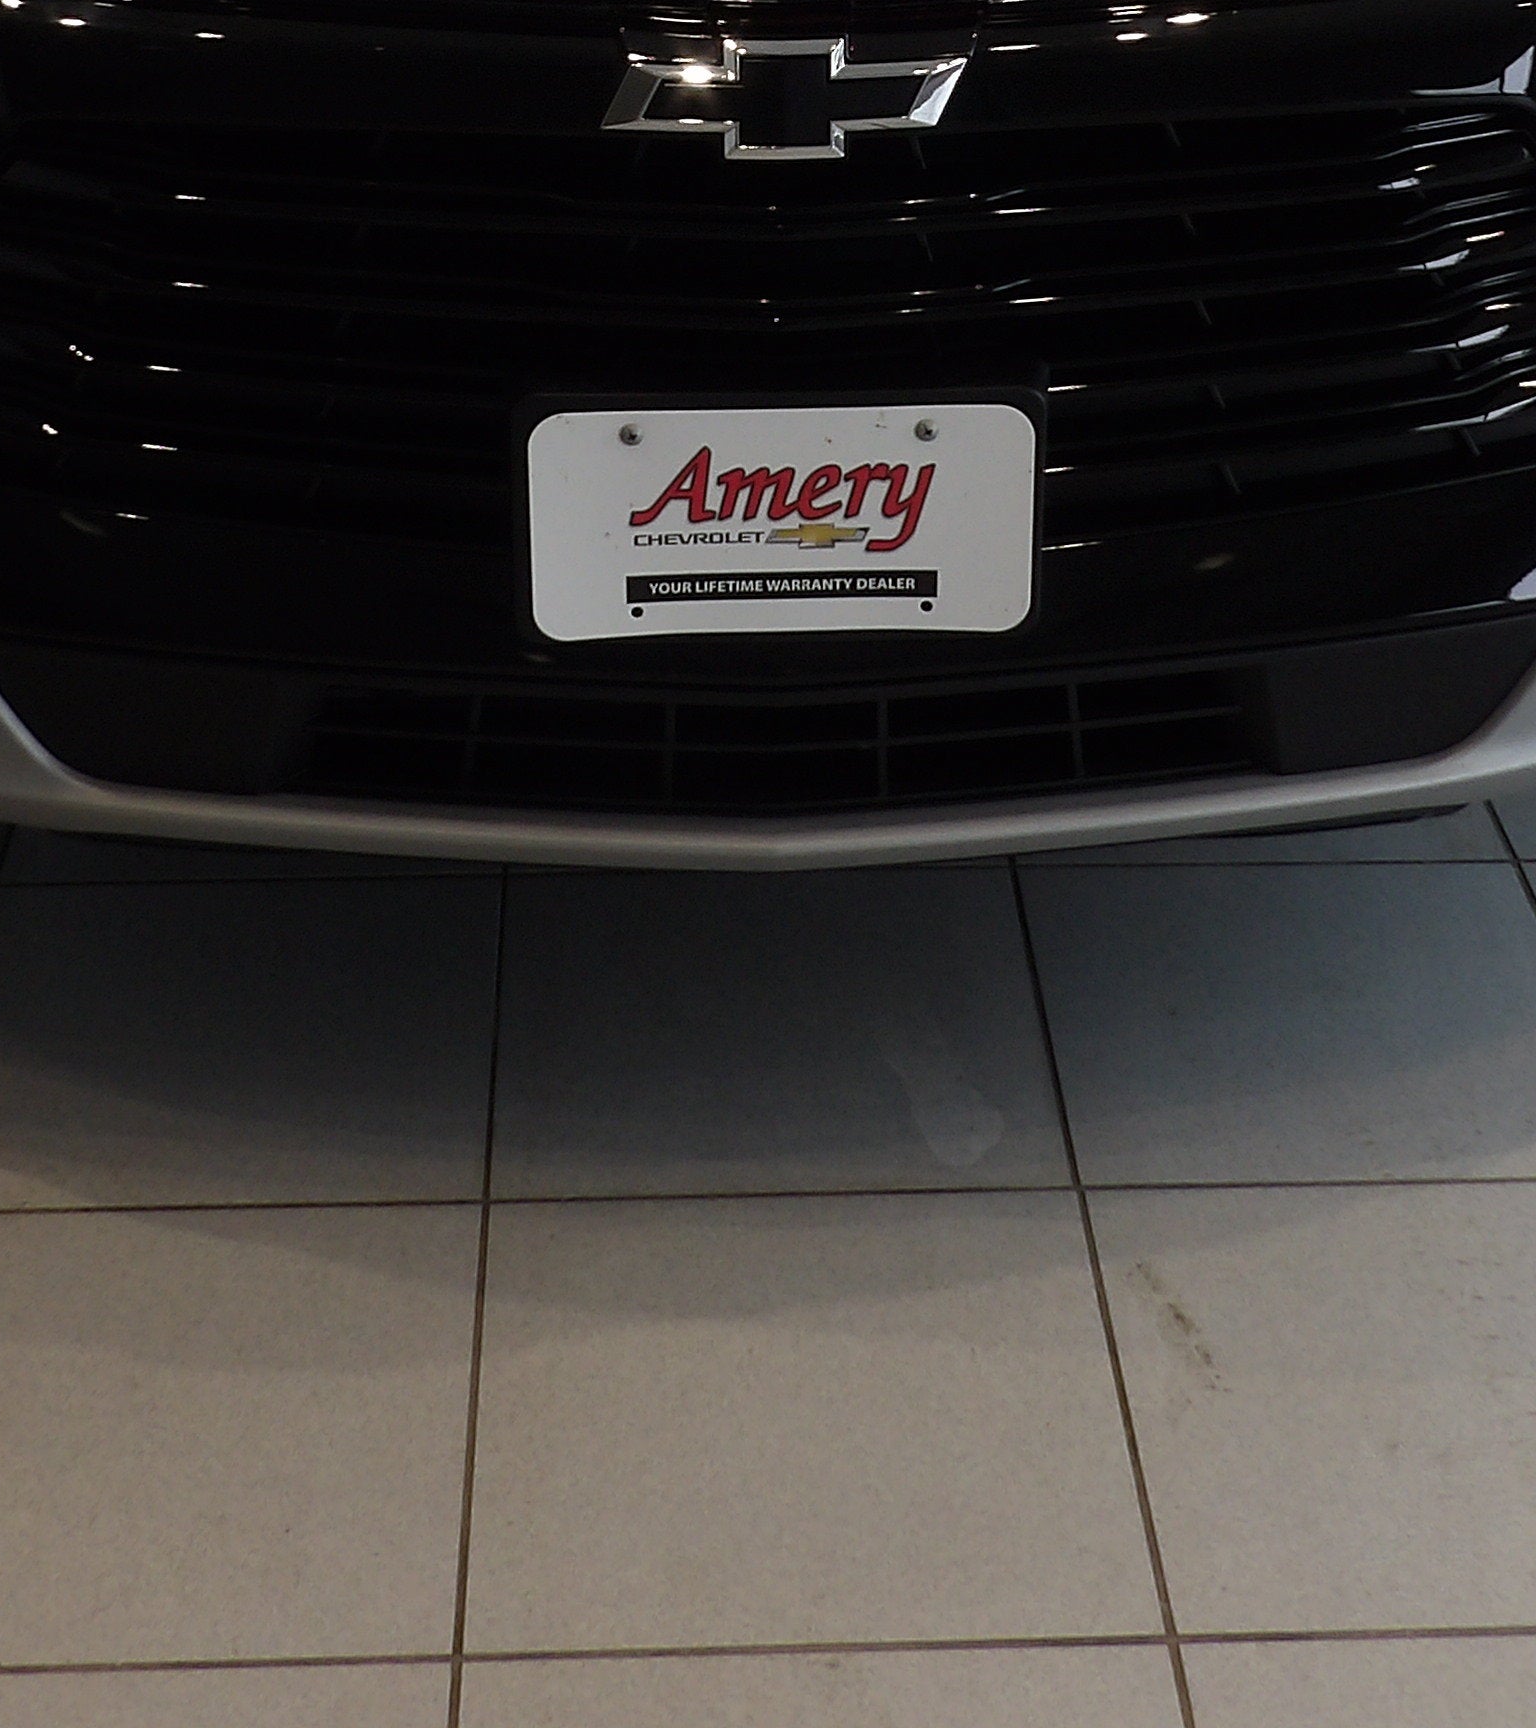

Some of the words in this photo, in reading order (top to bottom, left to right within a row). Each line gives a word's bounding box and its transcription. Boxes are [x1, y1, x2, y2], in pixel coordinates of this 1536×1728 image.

[629, 445, 937, 552] Amery
[633, 531, 765, 546] CHEVROLET
[649, 581, 692, 594] YOUR
[695, 580, 763, 593] LIFETIME
[766, 578, 853, 592] WARRANTY
[856, 577, 916, 590] DEALER
